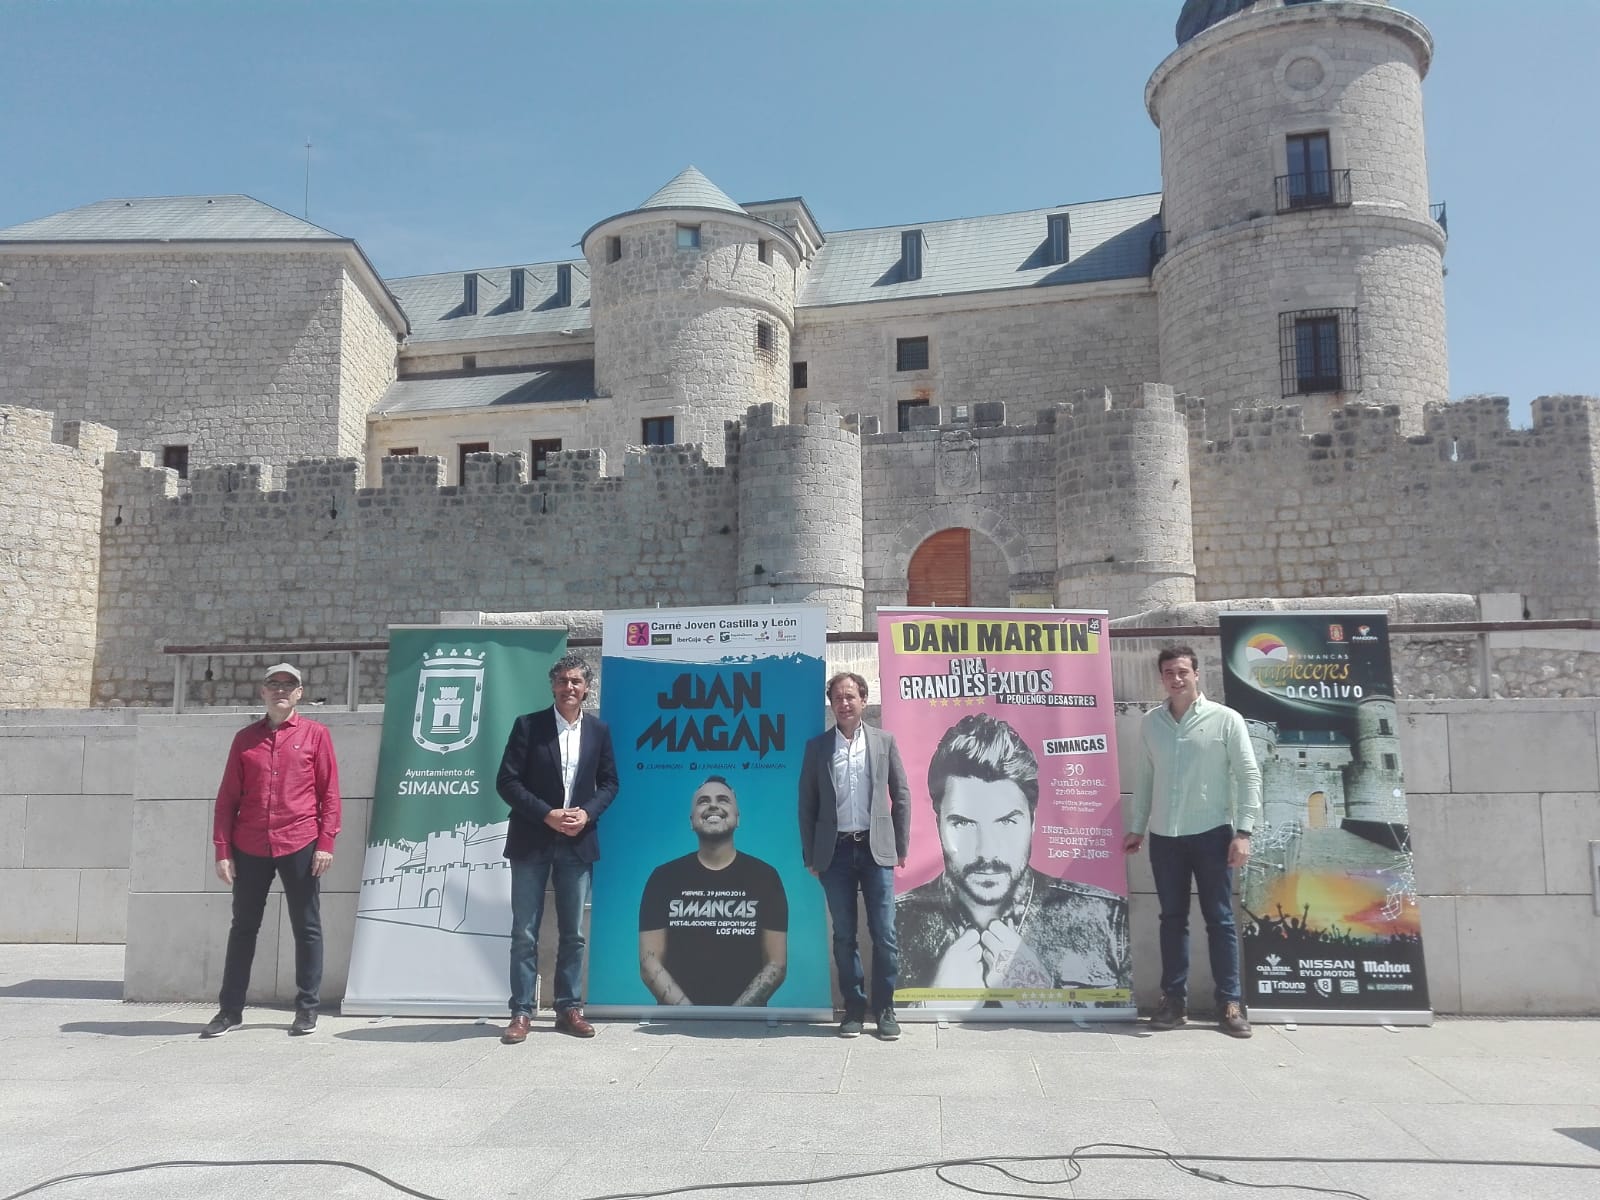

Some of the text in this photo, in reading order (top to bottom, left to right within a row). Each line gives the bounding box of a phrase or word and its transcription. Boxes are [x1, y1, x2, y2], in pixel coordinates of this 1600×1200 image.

[651, 618, 797, 630] Carné Joven Castilla y León
[902, 622, 969, 652] DANI
[950, 657, 985, 675] GIRA
[900, 667, 1054, 700] GRANDES ÉXITOS
[1286, 681, 1363, 699] archivo
[657, 671, 762, 718] JUAN
[999, 695, 1004, 704] Y
[1048, 695, 1096, 707] DESASTRES
[636, 713, 786, 761] MAGAN
[1046, 738, 1105, 754] SIMANCAS
[405, 768, 475, 778] Ayuntamiento de
[1065, 763, 1085, 776] 30
[398, 780, 480, 795] SIMANCAS
[668, 899, 760, 918] SIMANCAS
[732, 928, 756, 936] PINOS
[1299, 959, 1356, 969] NISSAN
[1362, 960, 1412, 974] Mahou
[1300, 969, 1356, 978] EYLO MOTOR
[1271, 980, 1306, 990] Tribuna
[1322, 980, 1329, 990] 8
